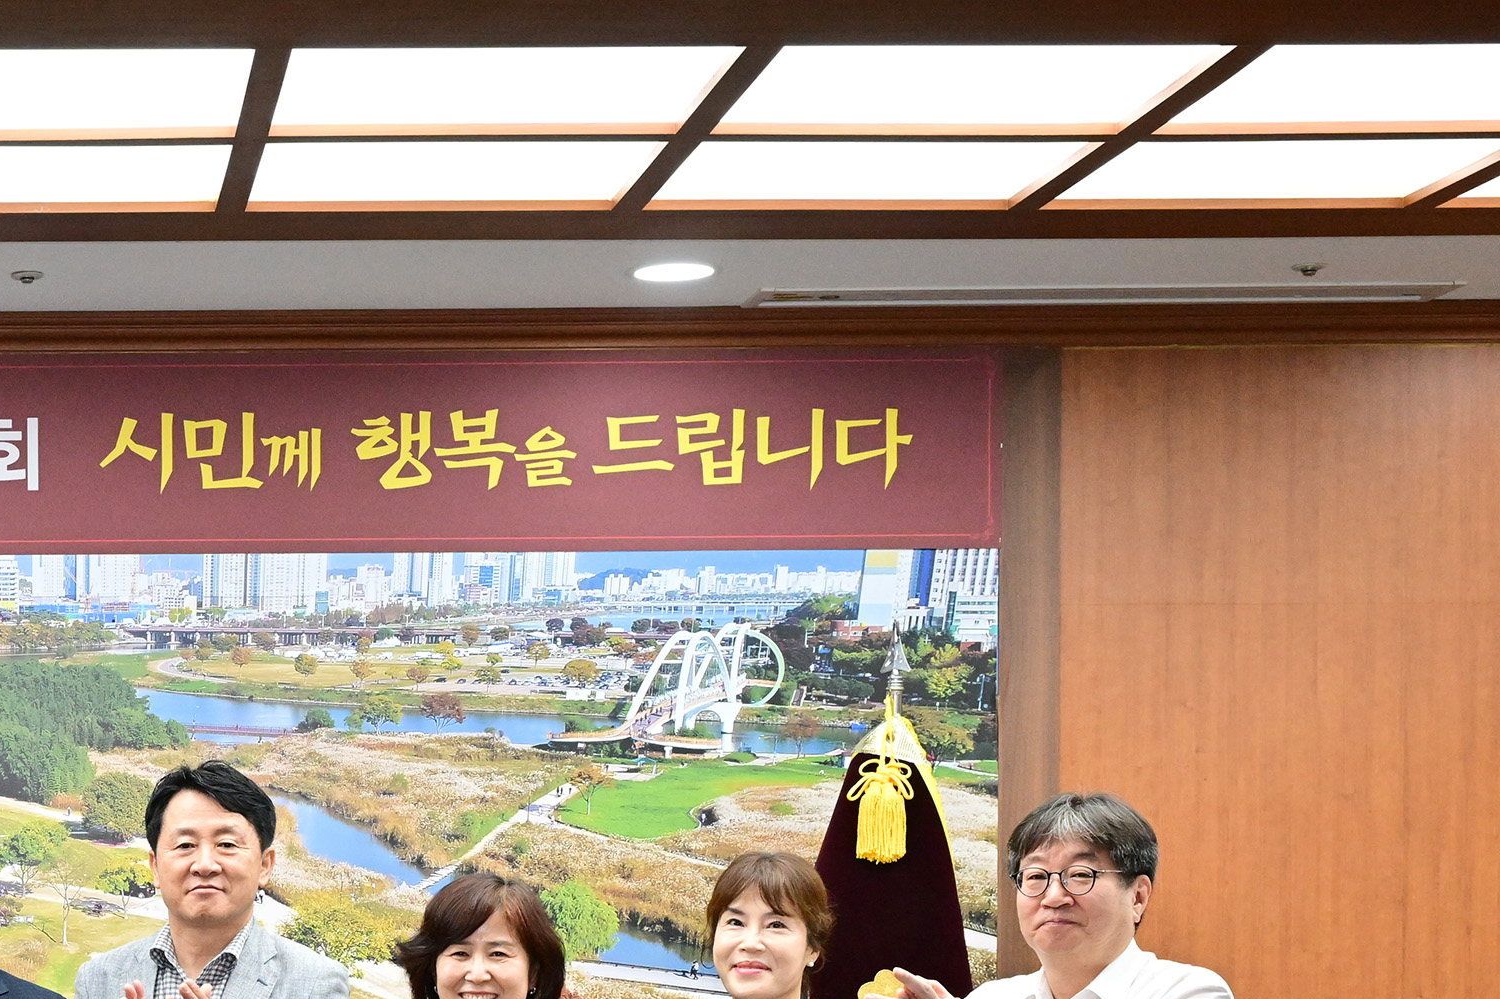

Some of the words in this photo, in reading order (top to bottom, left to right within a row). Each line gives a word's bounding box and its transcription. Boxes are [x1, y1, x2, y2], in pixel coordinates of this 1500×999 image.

[100, 411, 322, 493] 시민께
[351, 408, 578, 491] 행복을
[592, 407, 913, 490] 드립니다
